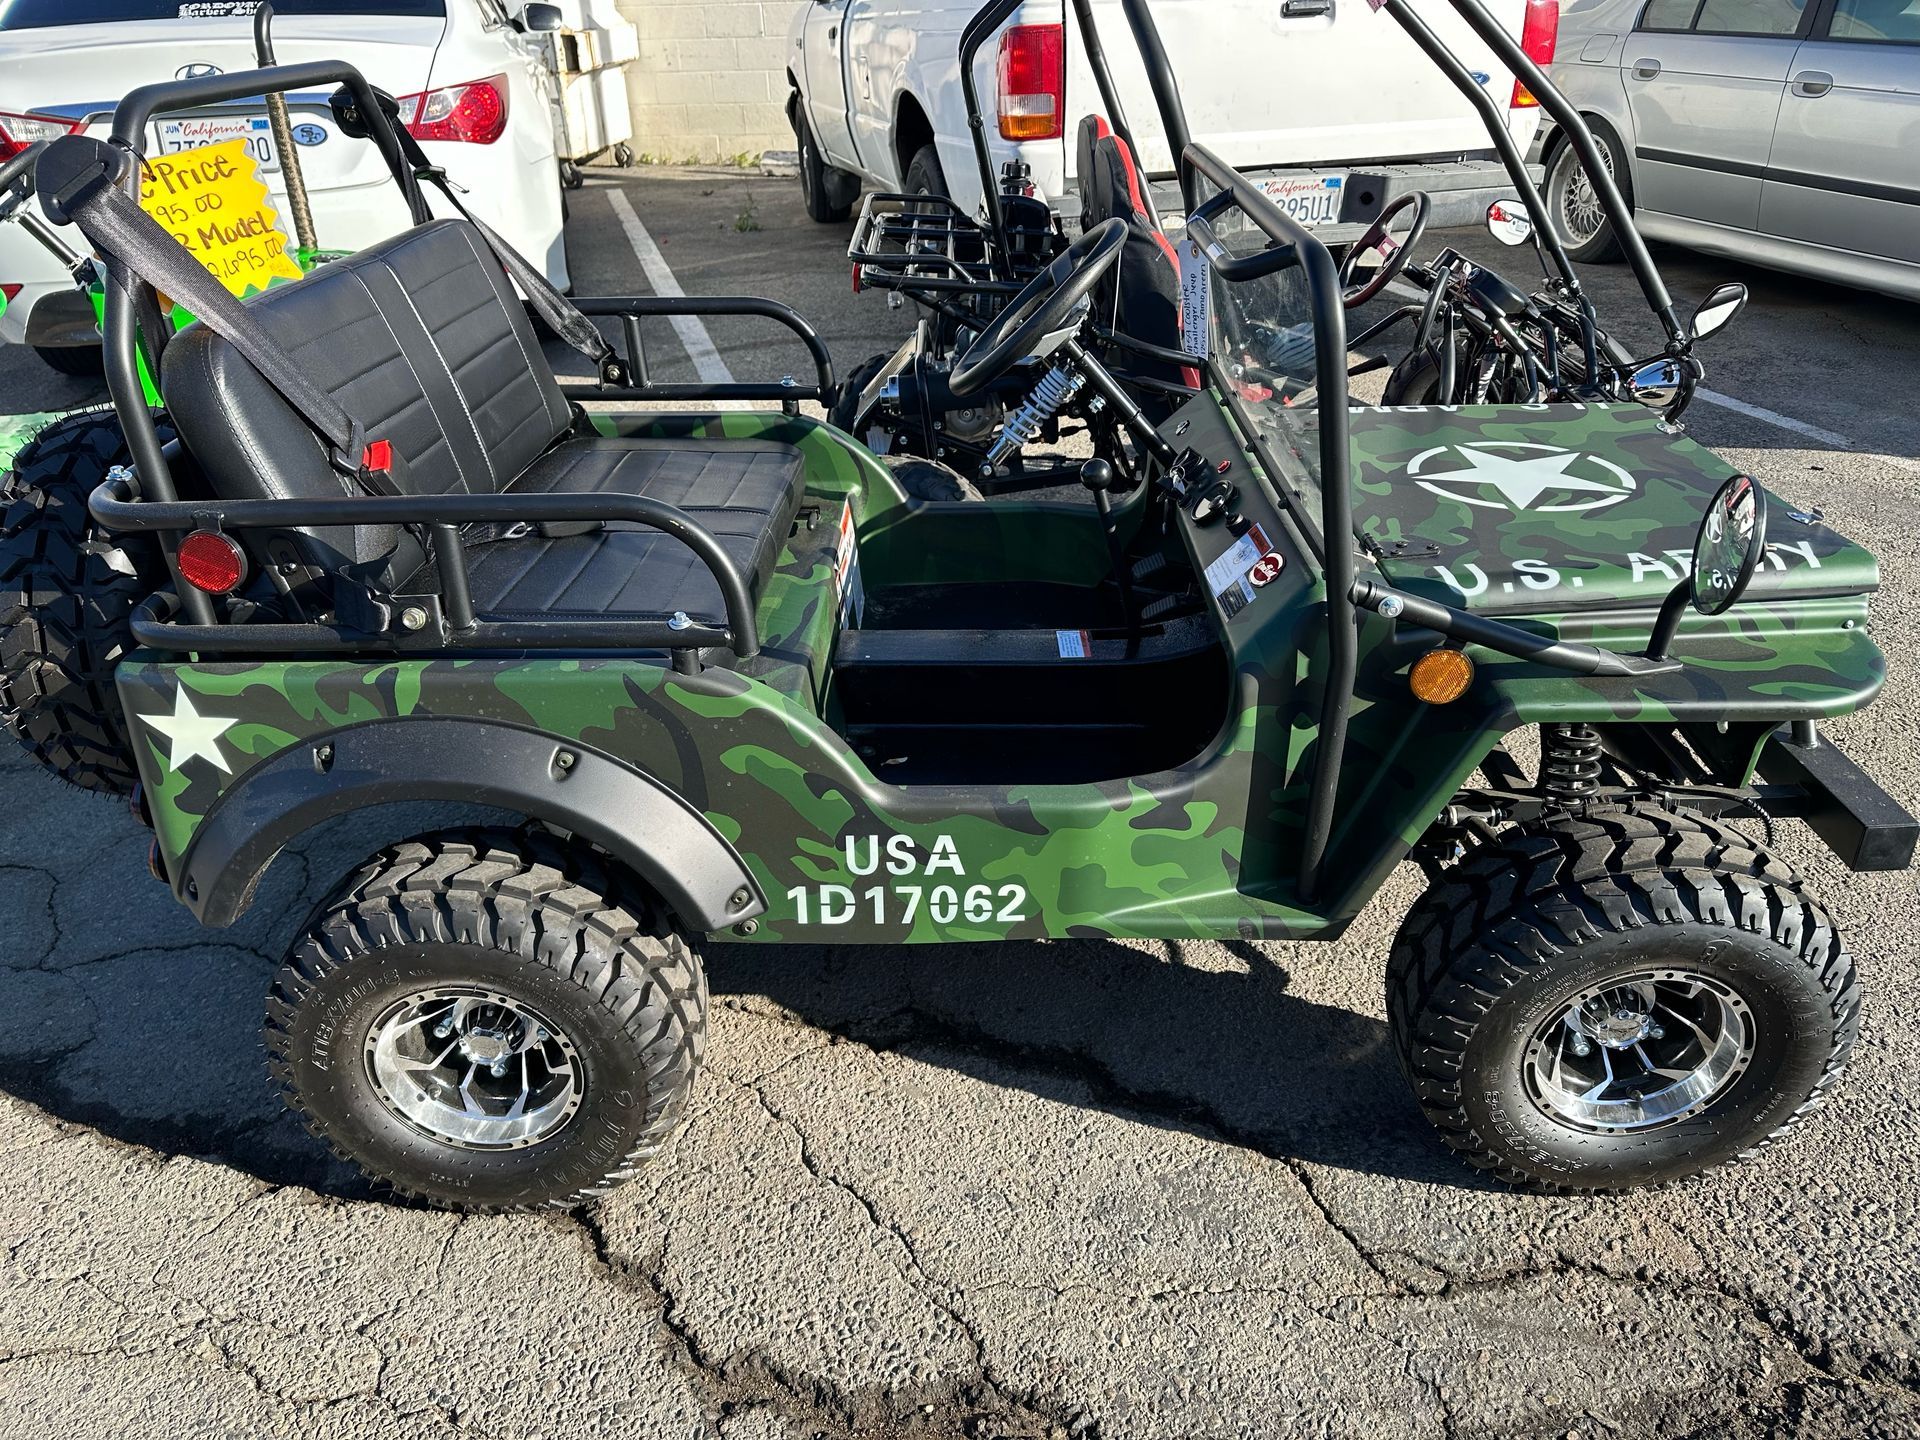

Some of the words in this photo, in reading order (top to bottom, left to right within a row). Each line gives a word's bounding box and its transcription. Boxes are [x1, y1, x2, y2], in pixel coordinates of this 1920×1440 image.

[231, 8, 258, 16] Sh
[165, 125, 179, 134] JUN
[183, 121, 251, 139] California
[155, 154, 238, 194] Price
[1266, 180, 1324, 197] California
[150, 192, 223, 225] 95.00
[196, 210, 275, 250] Model
[1432, 558, 1584, 597] U.S.
[845, 834, 966, 876] USA
[786, 883, 1026, 925] 1D17062
